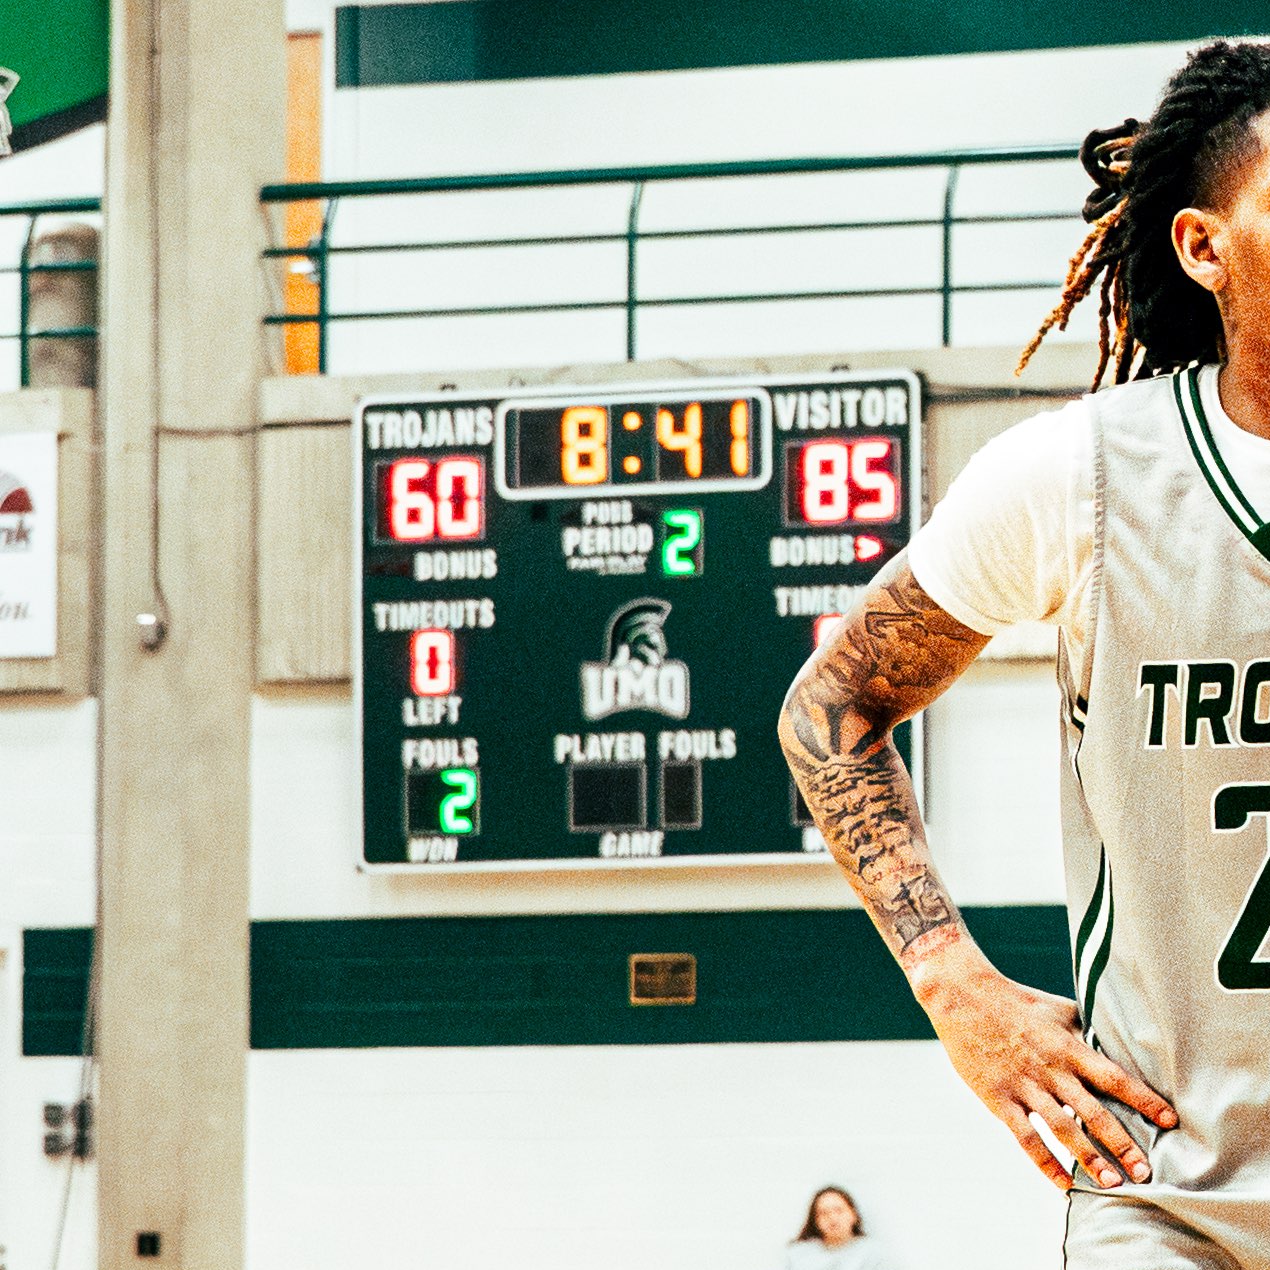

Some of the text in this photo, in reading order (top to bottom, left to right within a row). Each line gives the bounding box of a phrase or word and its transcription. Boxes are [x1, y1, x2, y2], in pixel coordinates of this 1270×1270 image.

[366, 405, 493, 449] TROJANS
[774, 387, 908, 430] VISITOR
[561, 399, 749, 485] 8:41
[389, 455, 483, 542] 60
[801, 437, 897, 524] 85
[562, 524, 654, 557] PERIOD
[661, 508, 701, 577] 2
[770, 534, 854, 567] BONUS
[413, 549, 498, 581] BONUS
[373, 598, 496, 632] TIMEOUTS
[774, 584, 868, 617] TIMEO
[409, 629, 456, 697] 0
[402, 697, 462, 727] LEFT
[583, 661, 690, 720] UMO
[402, 738, 479, 769] FOULS
[553, 728, 737, 764] PLAYER FOULS
[440, 768, 477, 834] 2
